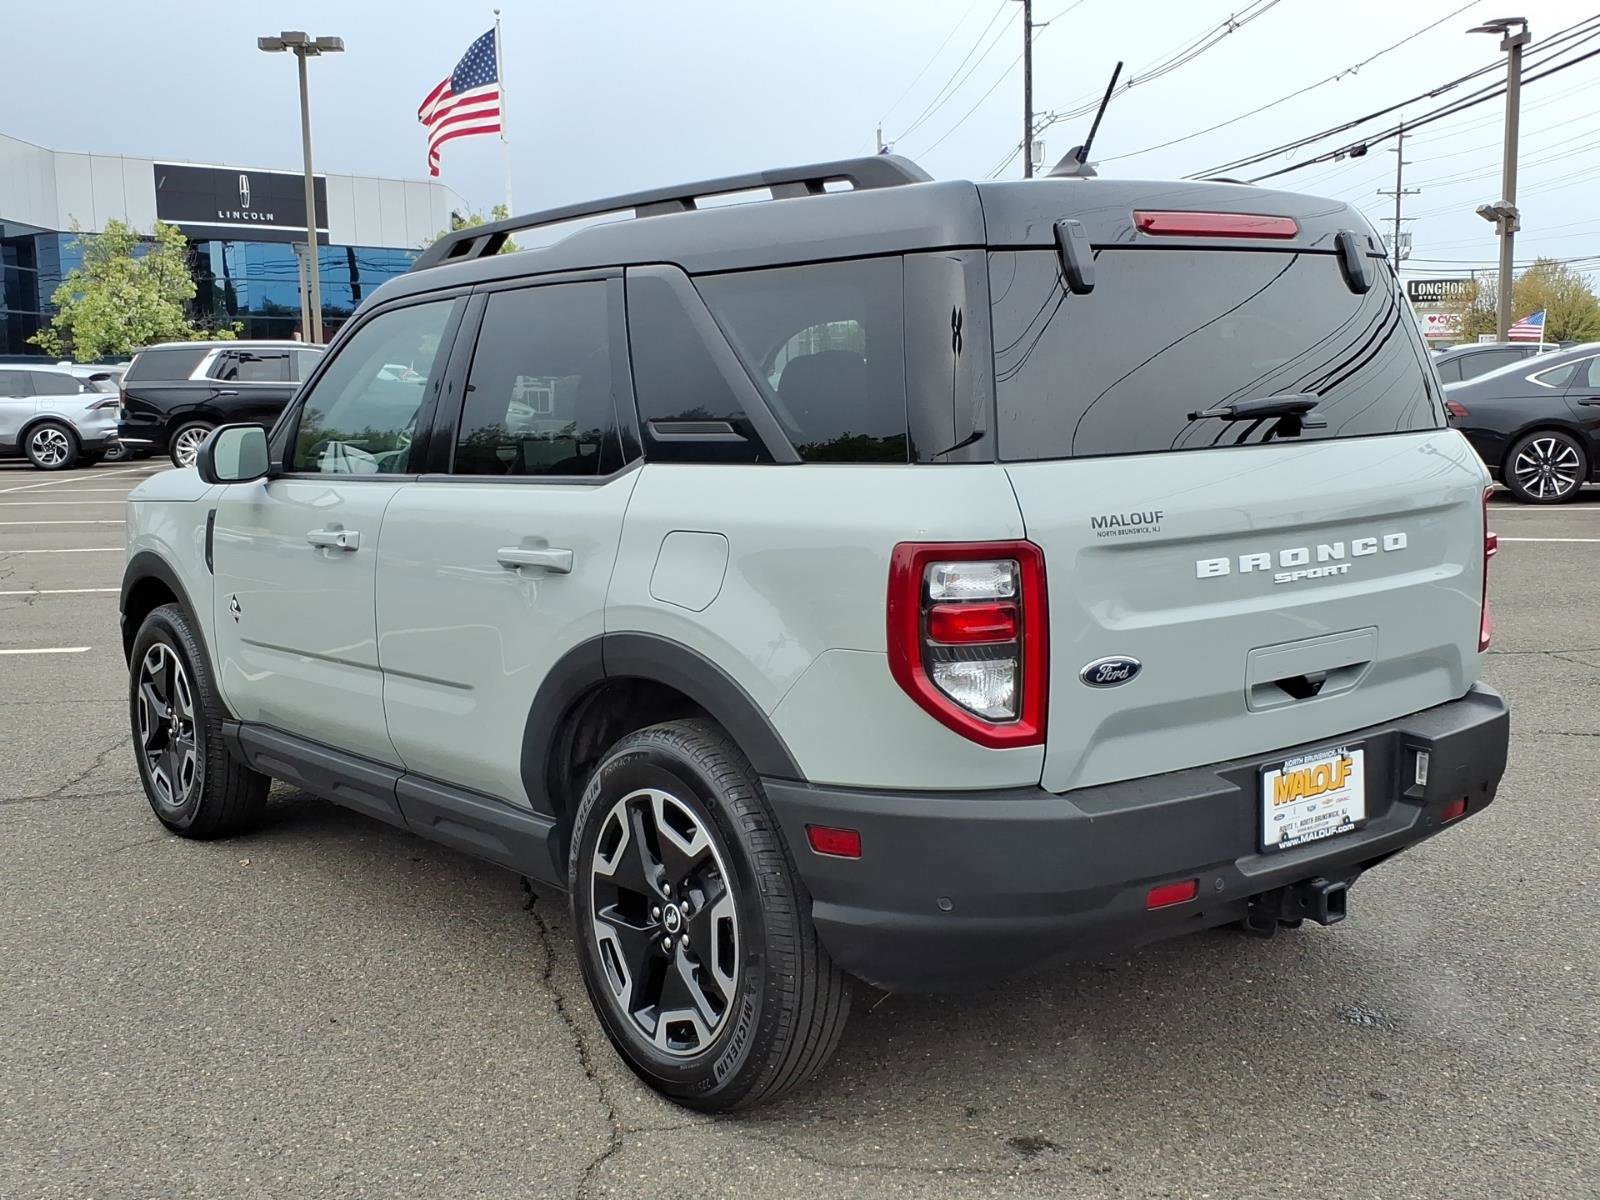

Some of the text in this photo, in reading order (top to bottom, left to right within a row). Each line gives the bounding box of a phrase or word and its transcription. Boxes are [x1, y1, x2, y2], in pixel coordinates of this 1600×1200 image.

[217, 210, 274, 221] LINCOLN
[1091, 510, 1164, 529] MALOUF
[1097, 530, 1117, 538] NORTH
[1196, 532, 1408, 579] BRONCO
[1274, 563, 1352, 584] SPORT
[1096, 662, 1131, 684] Ford
[1273, 758, 1353, 806] MALOUF
[1278, 823, 1355, 849] www.MALOUF.com
[716, 1000, 753, 1078] MICHELIN
